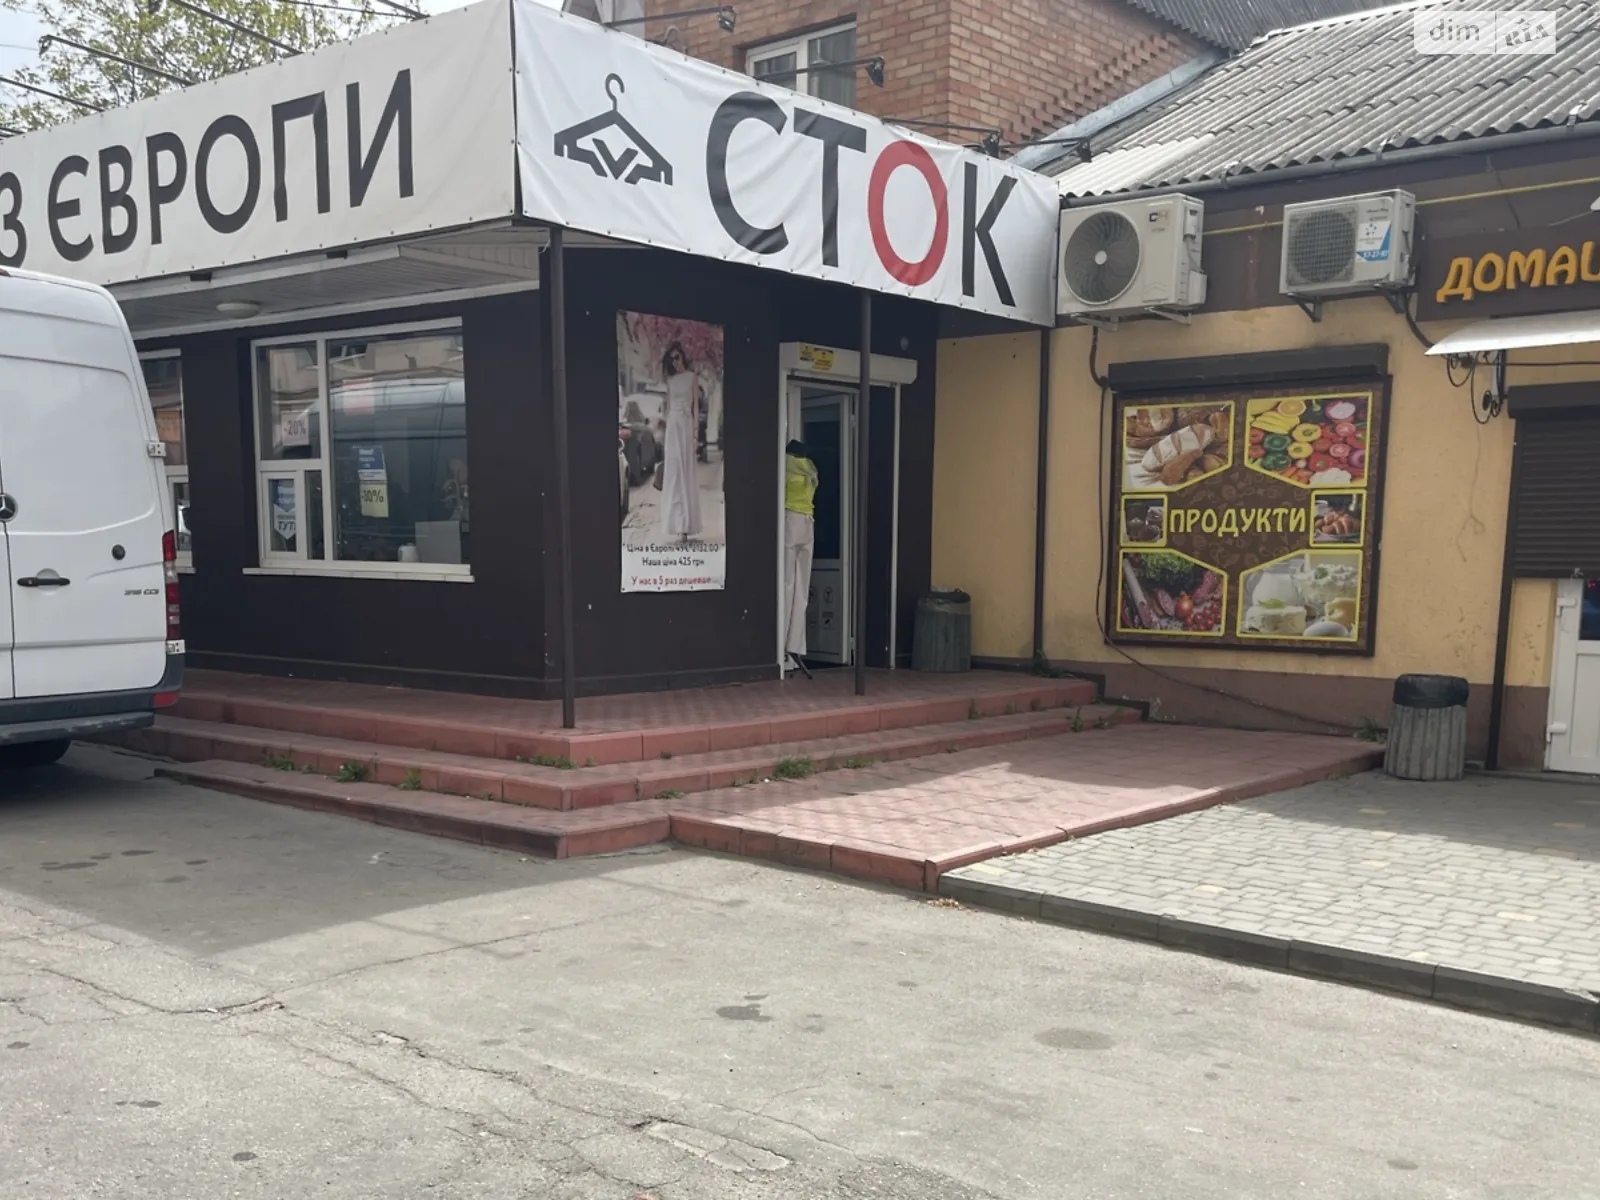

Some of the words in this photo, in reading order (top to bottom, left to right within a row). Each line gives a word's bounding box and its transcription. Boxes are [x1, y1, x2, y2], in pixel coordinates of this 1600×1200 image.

[48, 69, 414, 262] ЄВРОПИ
[706, 91, 1018, 307] СТОК
[1170, 507, 1307, 537] ПРОДУКТИ
[642, 557, 661, 566] Наша
[662, 557, 677, 567] ціна
[631, 576, 638, 585] У
[639, 577, 651, 585] нас
[658, 575, 664, 585] 5
[665, 577, 677, 587] раз
